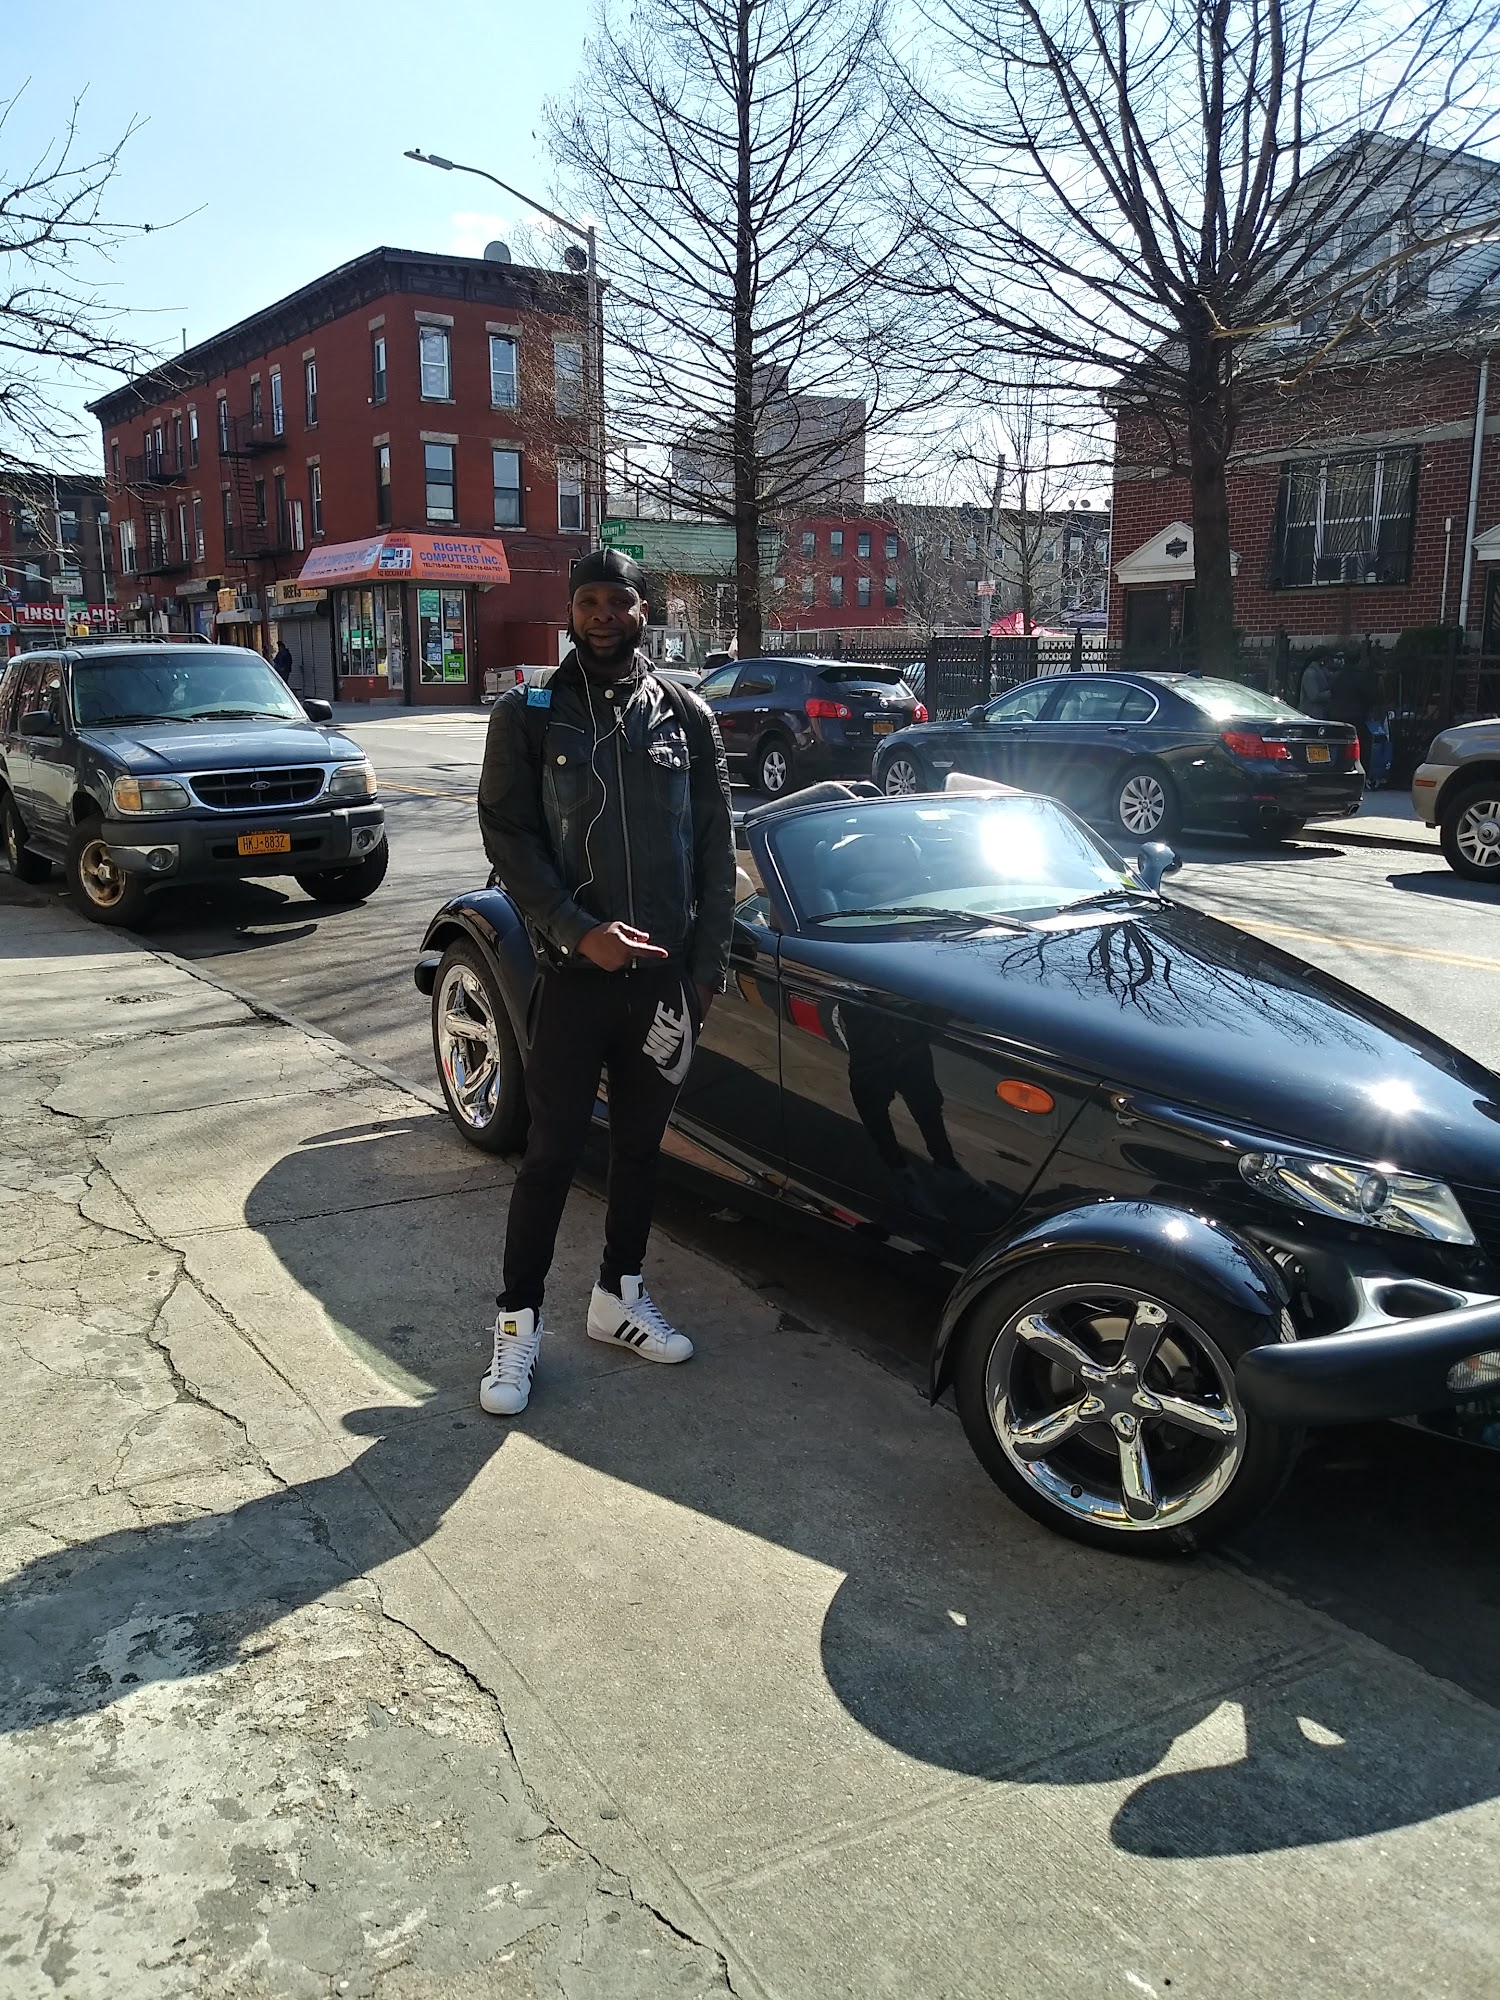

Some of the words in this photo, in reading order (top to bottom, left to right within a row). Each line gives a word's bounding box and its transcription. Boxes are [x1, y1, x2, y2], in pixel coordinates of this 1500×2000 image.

[433, 542, 482, 554] RIGHT-IT
[420, 552, 479, 563] COMPUTERS
[482, 557, 502, 565] INC.
[641, 1000, 685, 1067] NIKE
